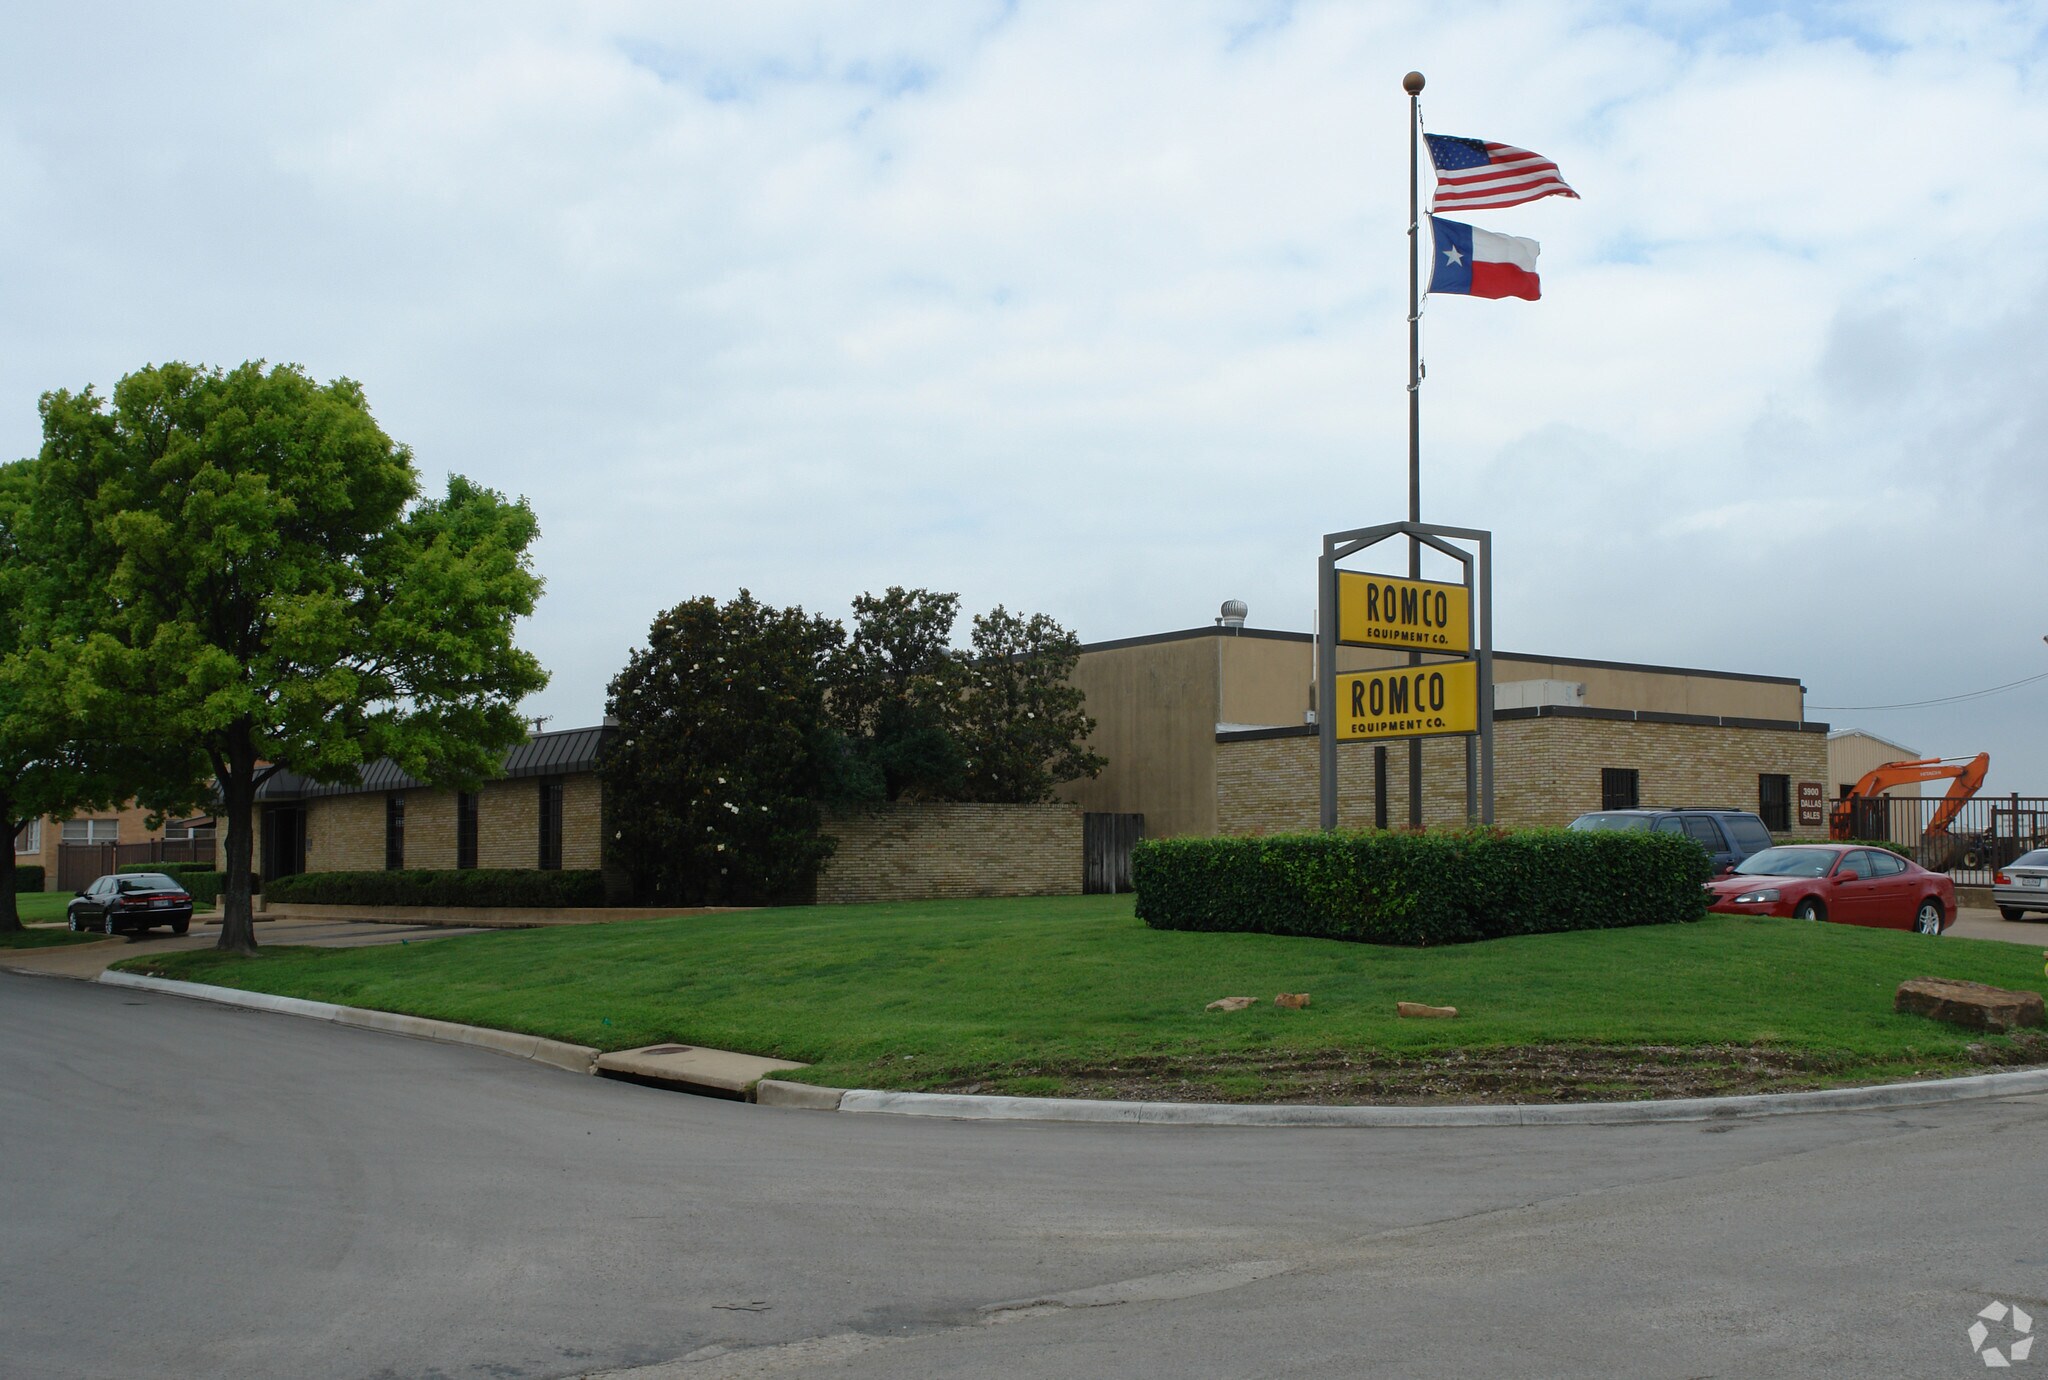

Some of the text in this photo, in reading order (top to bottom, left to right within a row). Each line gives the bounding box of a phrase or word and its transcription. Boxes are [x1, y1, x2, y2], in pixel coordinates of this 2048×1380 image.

[1367, 583, 1447, 628] ROMCO
[1367, 628, 1449, 644] EQUIPMENT CO.
[1352, 672, 1444, 717] ROMCO
[1352, 717, 1446, 733] EQUIPMENT CO.
[1803, 788, 1819, 796] 3900
[1800, 799, 1822, 808] DALLAS
[1802, 811, 1821, 820] SALES
